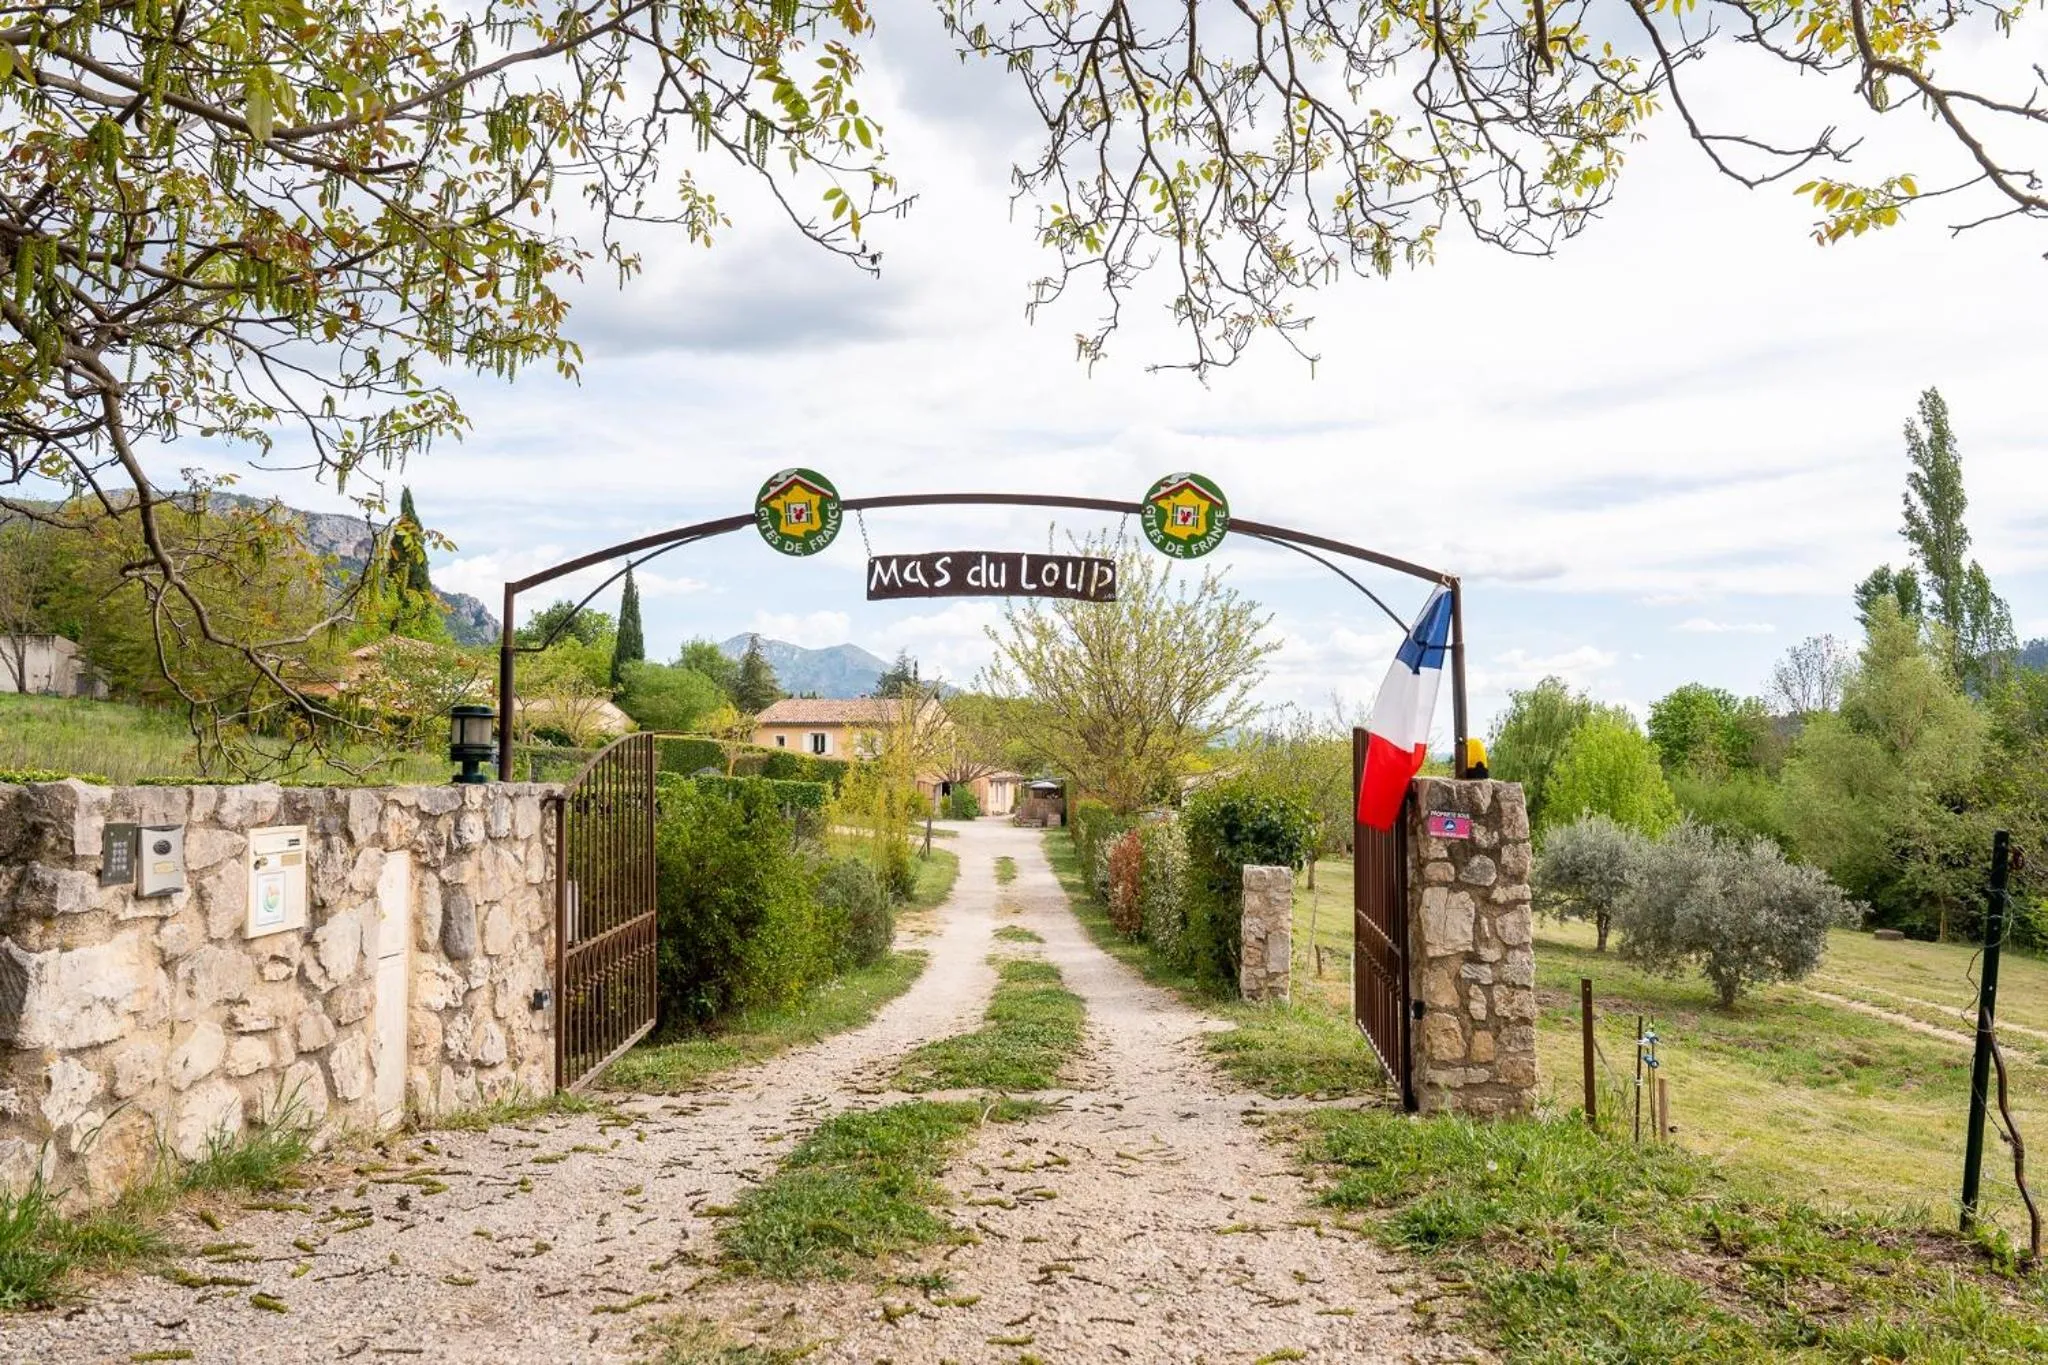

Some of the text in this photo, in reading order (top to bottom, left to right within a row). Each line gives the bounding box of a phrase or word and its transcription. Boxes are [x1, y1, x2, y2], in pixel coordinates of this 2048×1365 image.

[759, 502, 839, 553] GITES DE FRANCE
[1144, 505, 1225, 555] GITES DE FRANCE
[966, 554, 1006, 588] du
